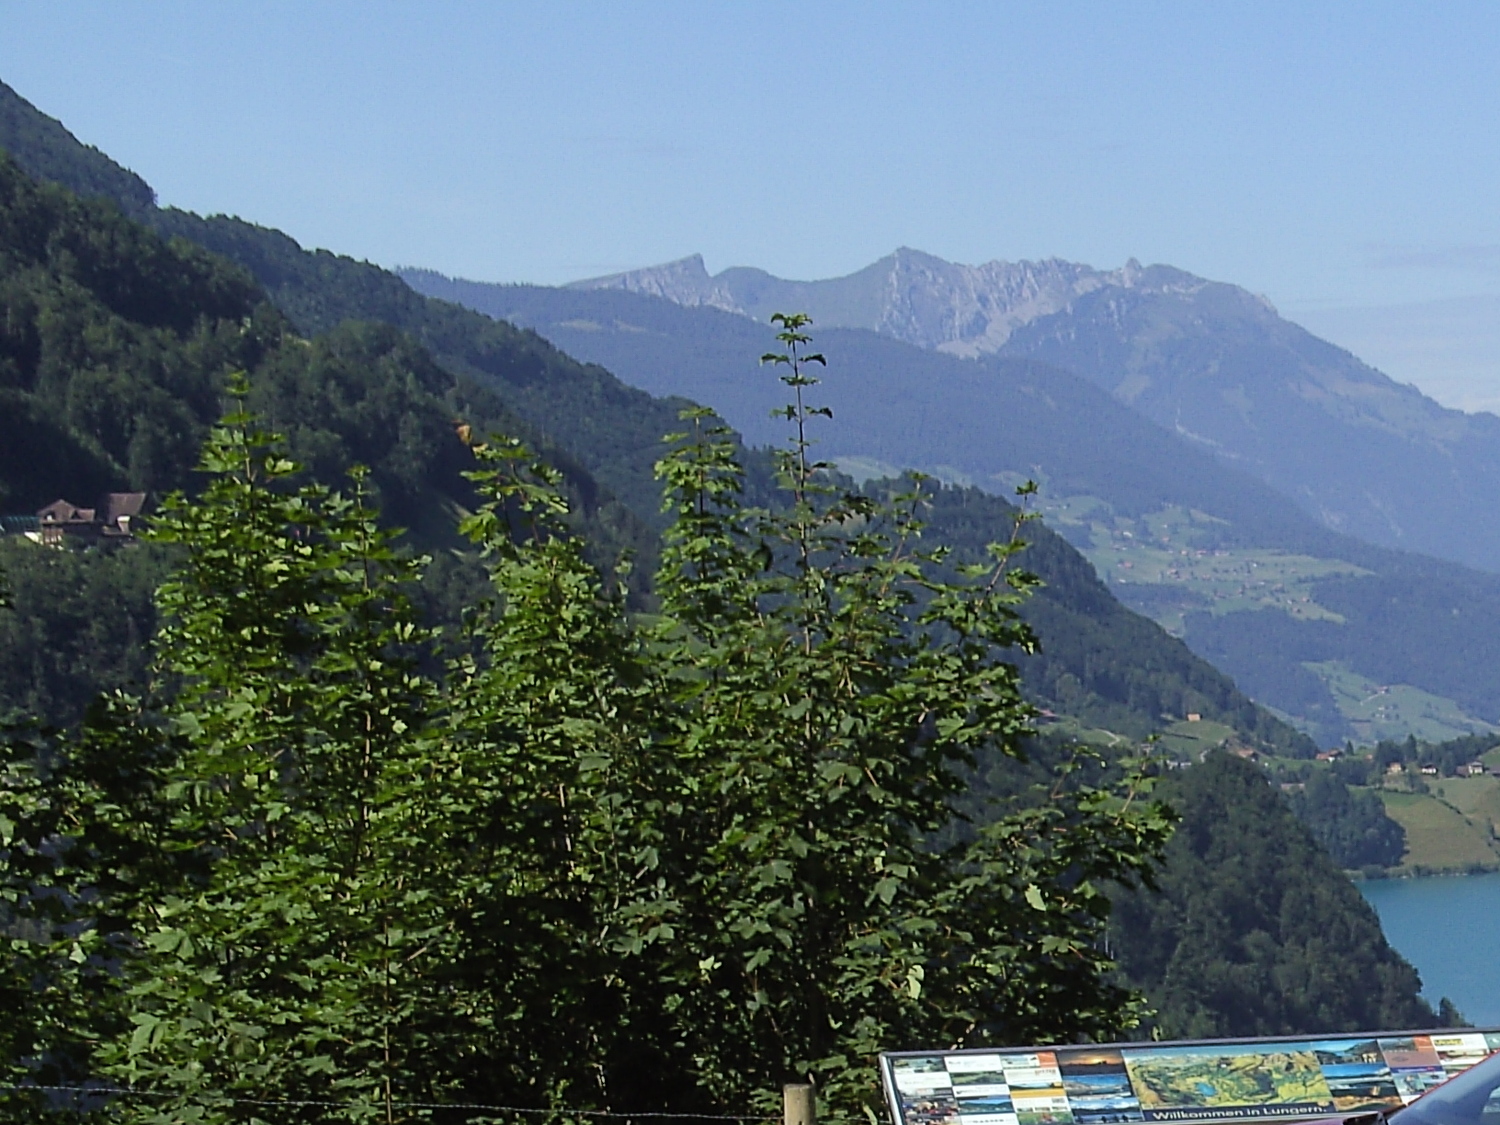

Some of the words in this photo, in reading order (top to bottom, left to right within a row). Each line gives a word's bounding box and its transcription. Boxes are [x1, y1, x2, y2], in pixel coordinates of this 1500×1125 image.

[1152, 1109, 1244, 1121] Willkommen
[1246, 1107, 1260, 1116] in
[1263, 1105, 1327, 1116] Lungern.
